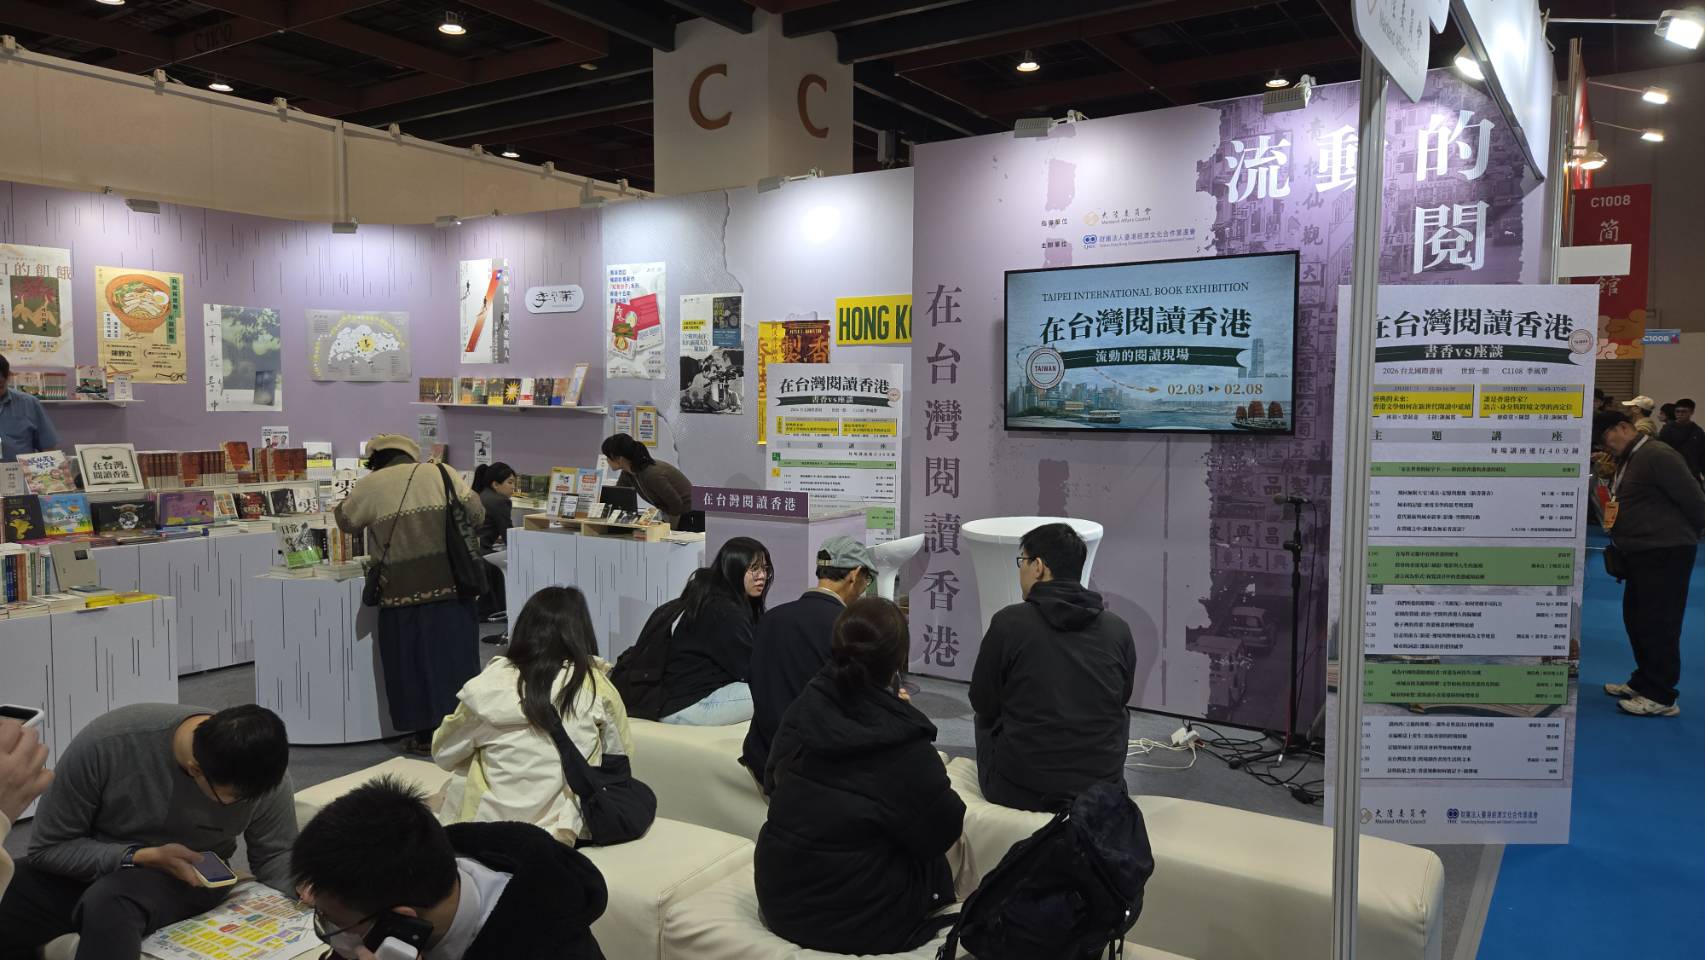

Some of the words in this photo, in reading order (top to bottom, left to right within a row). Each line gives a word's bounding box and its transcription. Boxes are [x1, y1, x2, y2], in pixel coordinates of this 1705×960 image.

[689, 64, 732, 130] C
[797, 74, 829, 138] C
[1590, 195, 1631, 208] C1008
[1041, 292, 1072, 302] TAIPEI
[1072, 287, 1152, 301] INTERNATIONAL
[1154, 285, 1183, 296] BOOK
[1185, 281, 1250, 295] EXHIBITION
[839, 305, 890, 341] HONG
[896, 303, 912, 340] K
[1039, 305, 1252, 345] 在台灣閱讀香港
[1095, 347, 1190, 363] 流動的閱讀現場
[1034, 364, 1057, 373] TAIWAN
[780, 376, 890, 395] 在台灣閱讀香港
[1167, 383, 1204, 396] 02.03
[1224, 383, 1263, 395] 02.08
[923, 284, 962, 667] 在台灣閱讀香港
[703, 491, 796, 512] 在台灣閱讀香港
